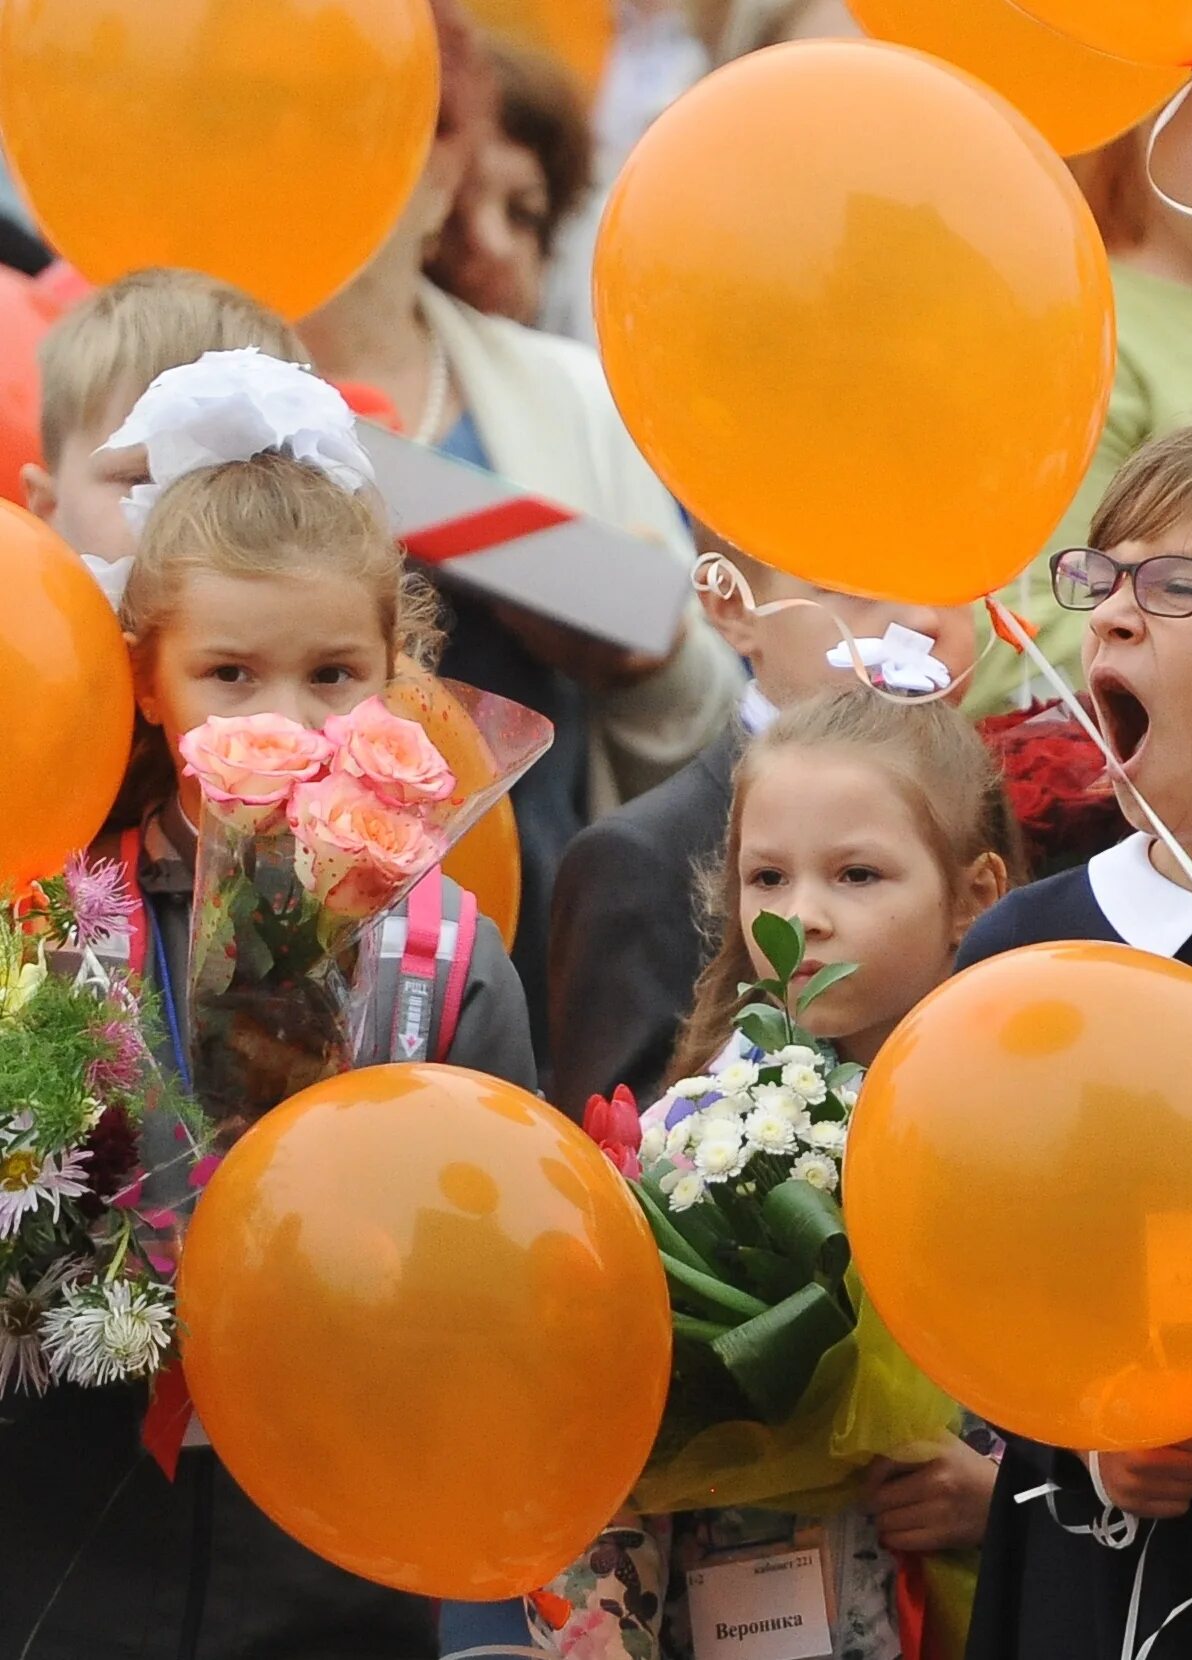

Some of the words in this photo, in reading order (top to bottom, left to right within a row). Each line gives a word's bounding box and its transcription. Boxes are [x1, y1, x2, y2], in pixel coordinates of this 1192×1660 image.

[404, 981, 428, 996] PULL
[796, 1555, 813, 1568] 221
[715, 1614, 803, 1641] Вероника
